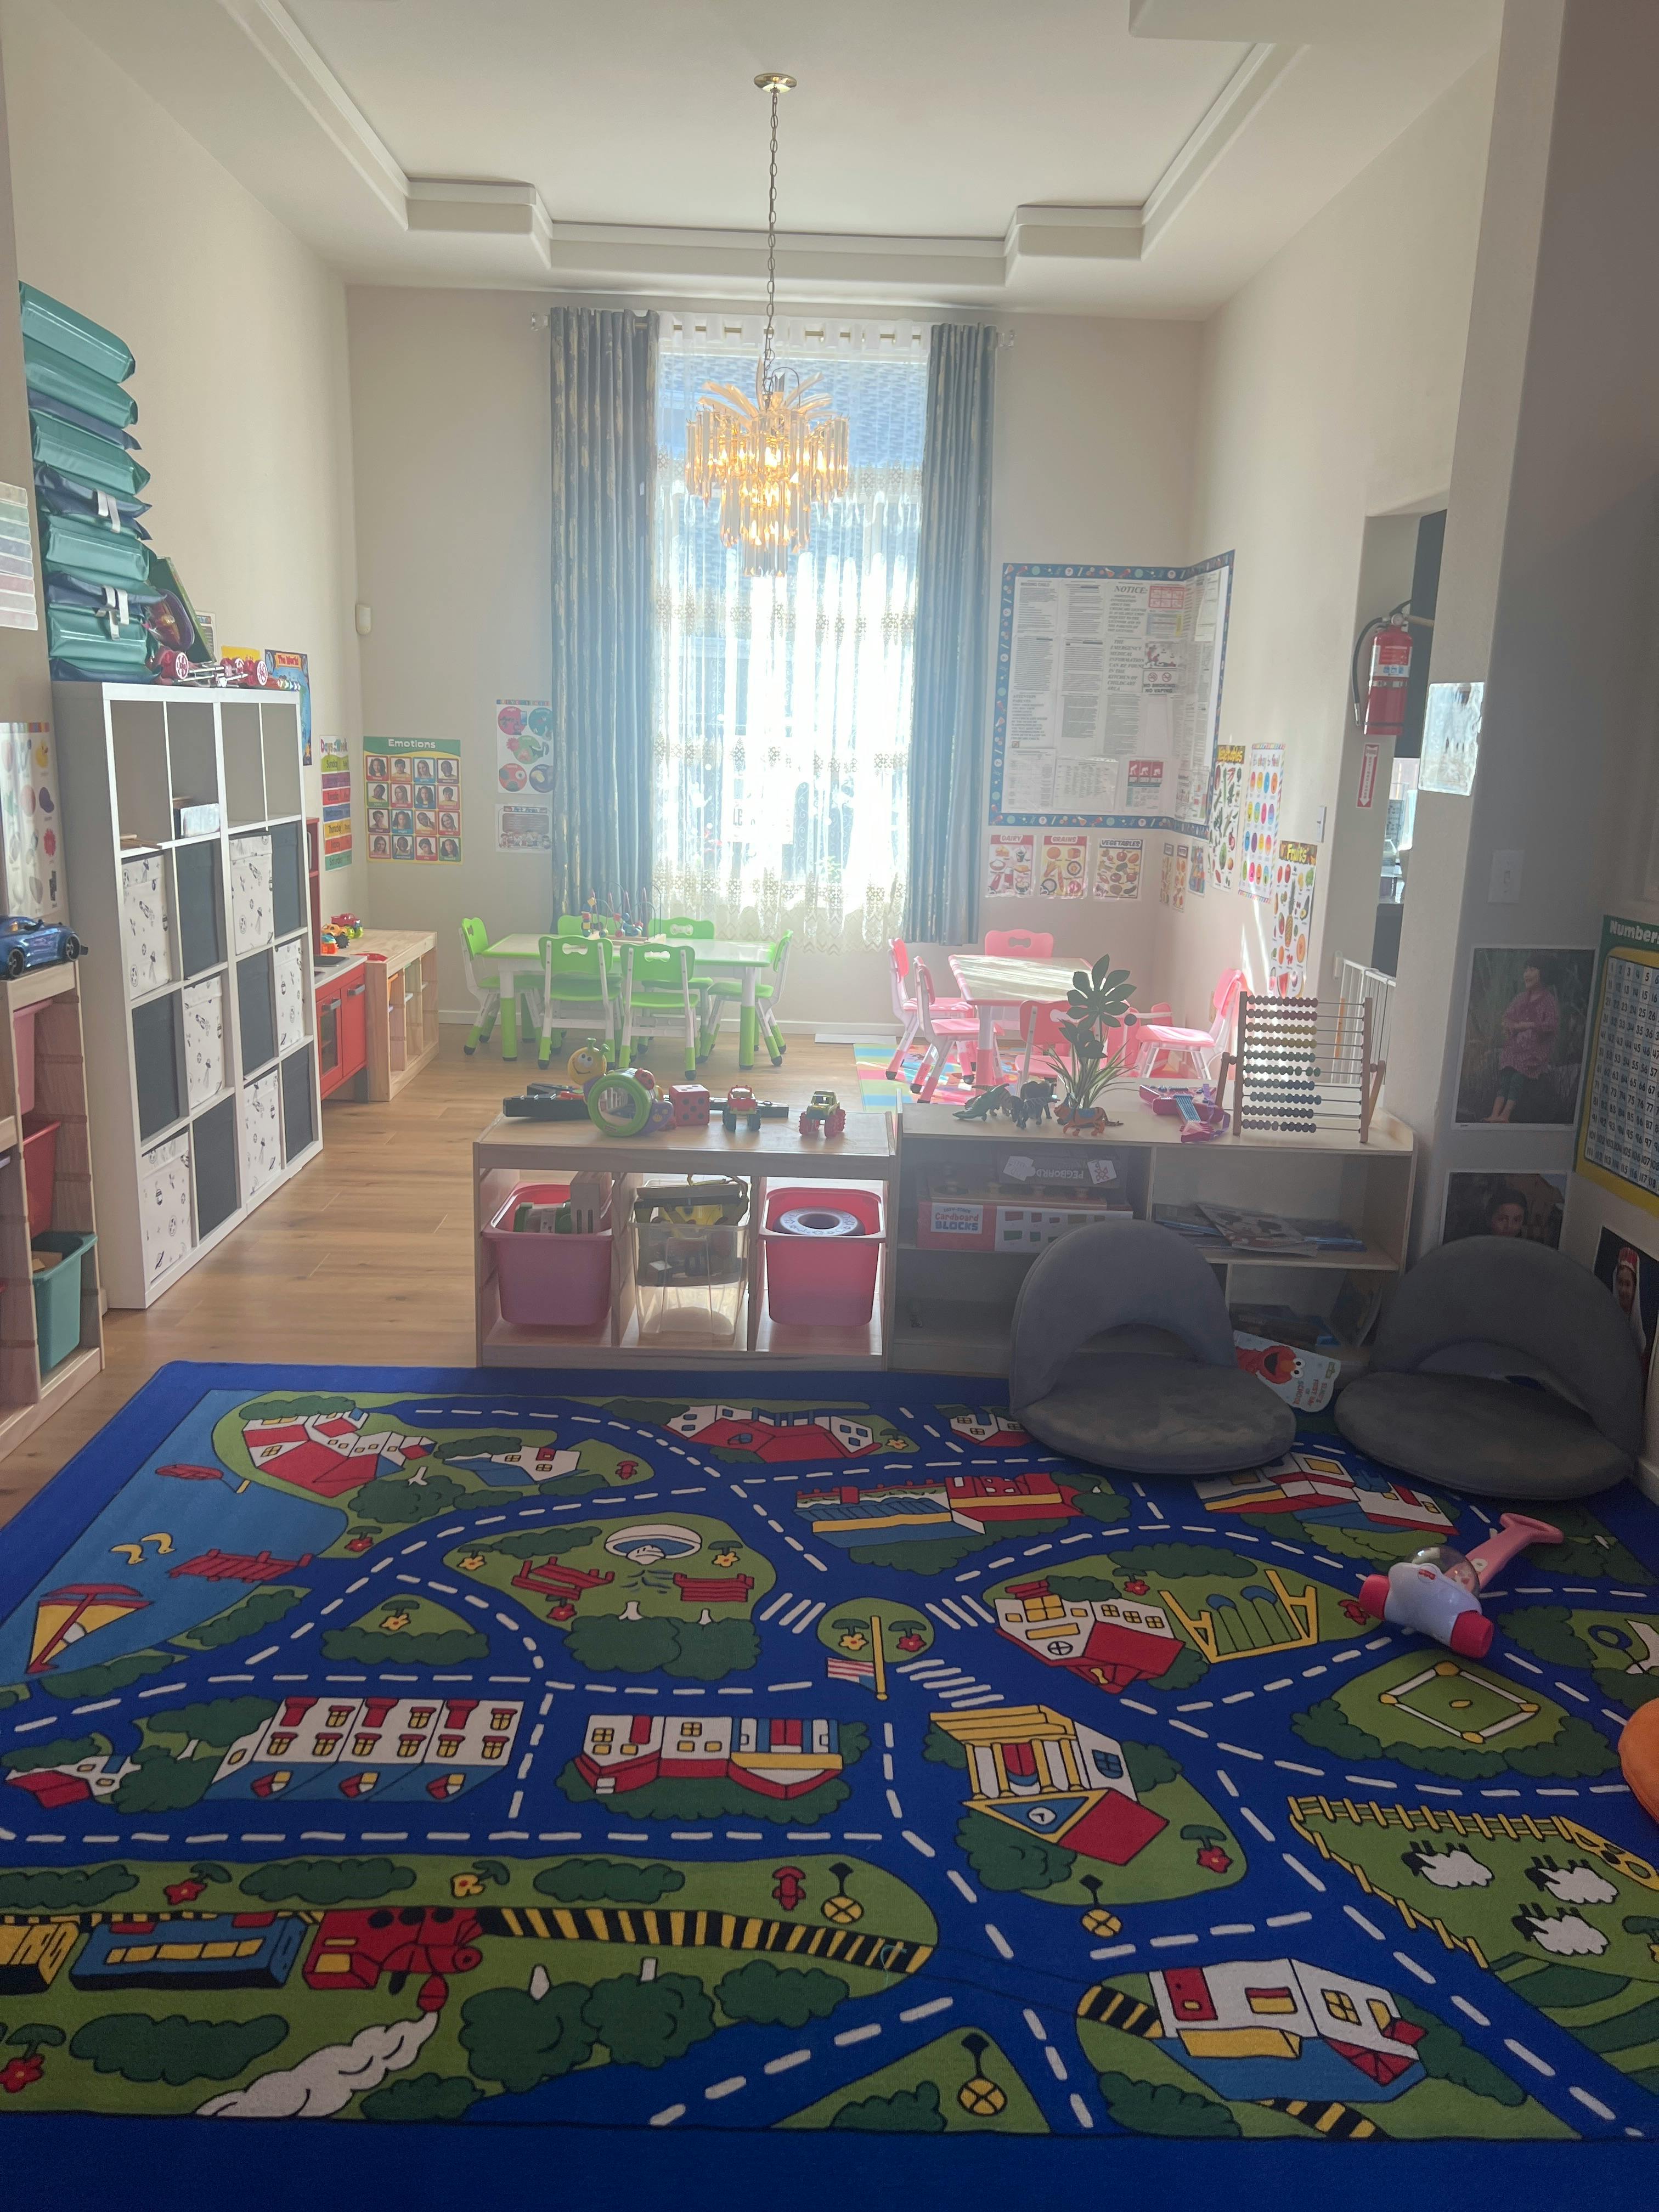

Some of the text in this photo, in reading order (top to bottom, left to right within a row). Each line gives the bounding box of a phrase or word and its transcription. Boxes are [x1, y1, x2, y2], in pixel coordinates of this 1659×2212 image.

[1114, 585, 1148, 594] NOTICE:
[388, 739, 436, 749] Emotions
[1618, 964, 1623, 975] 2
[1627, 967, 1631, 977] 3
[1635, 969, 1640, 979] 4
[1645, 972, 1650, 981] 5
[1641, 990, 1649, 1000] 15
[1651, 993, 1657, 1003] 16
[1621, 1001, 1628, 1012] 23
[1629, 1005, 1637, 1015] 24
[1638, 1007, 1646, 1018] 25
[1648, 1010, 1656, 1021] 26
[1618, 1019, 1626, 1029] 33
[1627, 1022, 1634, 1032] 34
[1636, 1025, 1644, 1036] 35
[1645, 1028, 1653, 1039] 36
[1617, 1037, 1623, 1046] 43
[1634, 1043, 1641, 1053] 45
[1643, 1047, 1650, 1057] 46
[1615, 1054, 1621, 1064] 53
[1632, 1060, 1639, 1070] 55
[1641, 1063, 1648, 1074] 56
[1650, 1067, 1658, 1077] 57
[1604, 1068, 1611, 1077] 62
[1612, 1070, 1619, 1081] 63
[1630, 1077, 1637, 1088] 65
[1639, 1081, 1646, 1092] 66
[1648, 1085, 1656, 1095] 67
[1611, 1087, 1617, 1098] 73
[1620, 1090, 1626, 1102] 74
[1628, 1094, 1635, 1105] 75
[1637, 1098, 1644, 1109] 76
[1646, 1102, 1654, 1113] 77
[1609, 1104, 1616, 1114] 83
[1627, 1111, 1634, 1122] 85
[1636, 1115, 1644, 1126] 86
[1645, 1120, 1652, 1130] 87
[1592, 1113, 1598, 1124] 91
[1600, 1116, 1606, 1127] 92
[1608, 1121, 1615, 1131] 93
[1617, 1125, 1623, 1136] 94
[1626, 1128, 1633, 1140] 95
[1635, 1133, 1642, 1144] 96
[1644, 1138, 1652, 1148] 97
[1597, 1134, 1605, 1145] 102
[1605, 1138, 1614, 1149] 103
[1623, 1147, 1632, 1158] 105
[1632, 1150, 1640, 1163] 106
[1641, 1155, 1650, 1166] 107
[1036, 1169, 1085, 1180] PEGBOARD
[1639, 1173, 1647, 1183] 117
[935, 1212, 979, 1222] Cardboard
[935, 1221, 979, 1231] BLOCKS
[1293, 1380, 1304, 1404] SCHOOL
